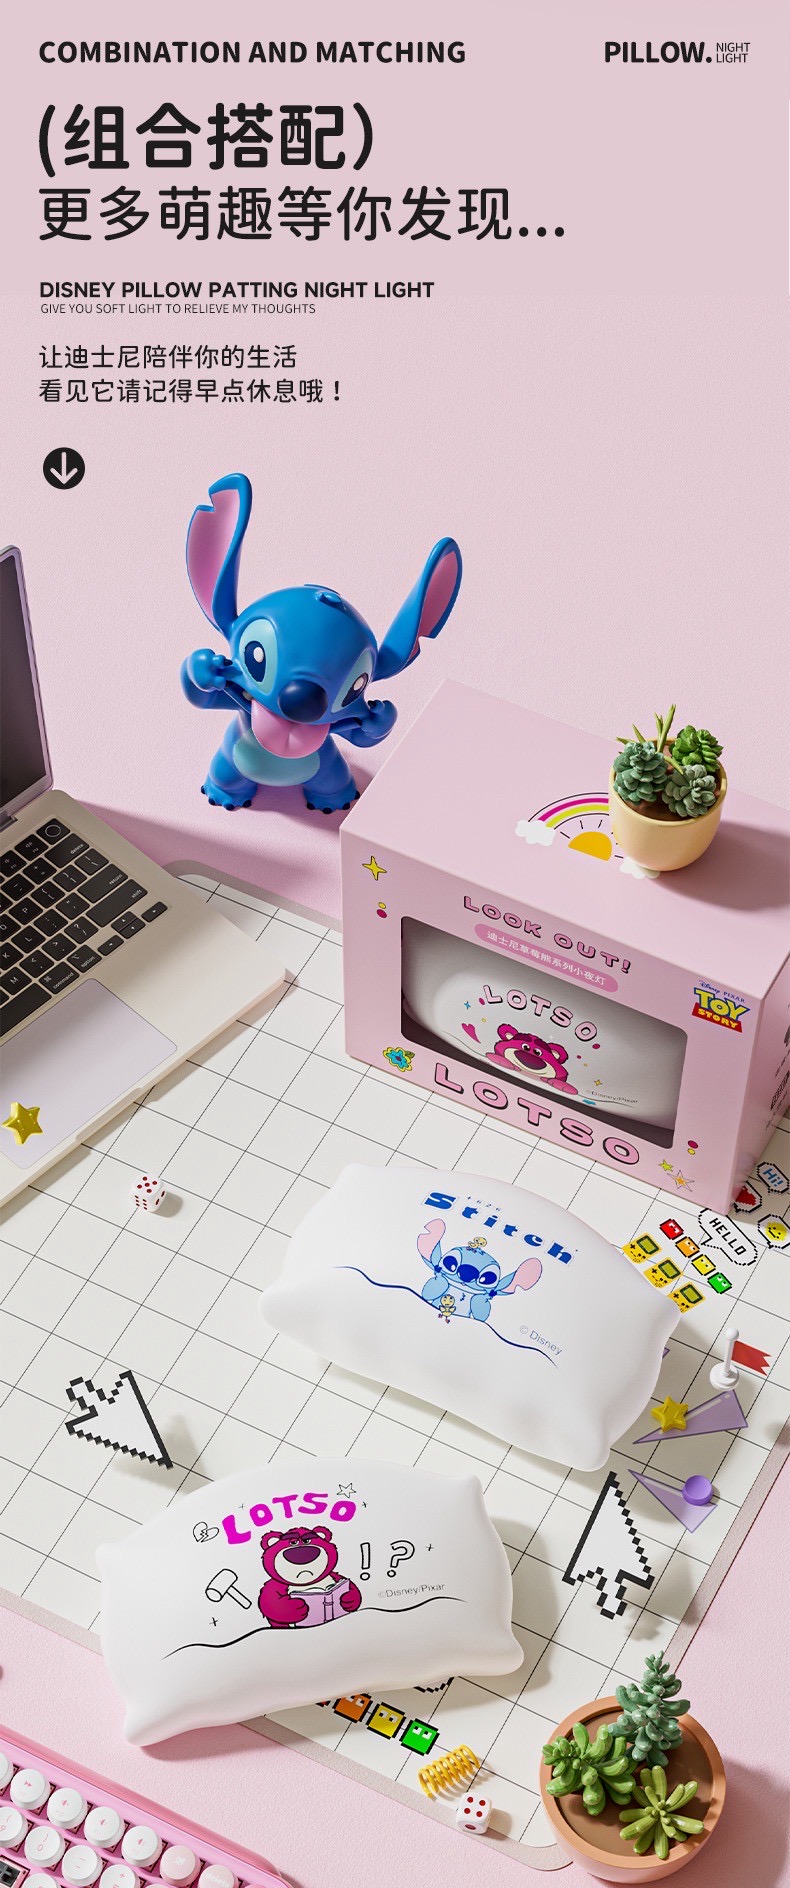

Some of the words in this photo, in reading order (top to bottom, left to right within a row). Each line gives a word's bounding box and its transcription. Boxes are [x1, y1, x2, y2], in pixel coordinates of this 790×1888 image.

[463, 895, 542, 939] LOOK
[553, 932, 632, 975] OUT!
[486, 930, 606, 986] 迪士尼草莓熊系列小夜灯
[483, 984, 599, 1043] LOTSO
[693, 986, 751, 1022] TOY
[697, 1008, 739, 1029] STORY
[434, 1062, 640, 1166] LOTSO
[763, 1168, 784, 1188] Hi!
[424, 1191, 573, 1265] Stitch
[709, 1217, 747, 1256] HELLO
[529, 1330, 563, 1356] Disney
[221, 1492, 357, 1545] LOTSO
